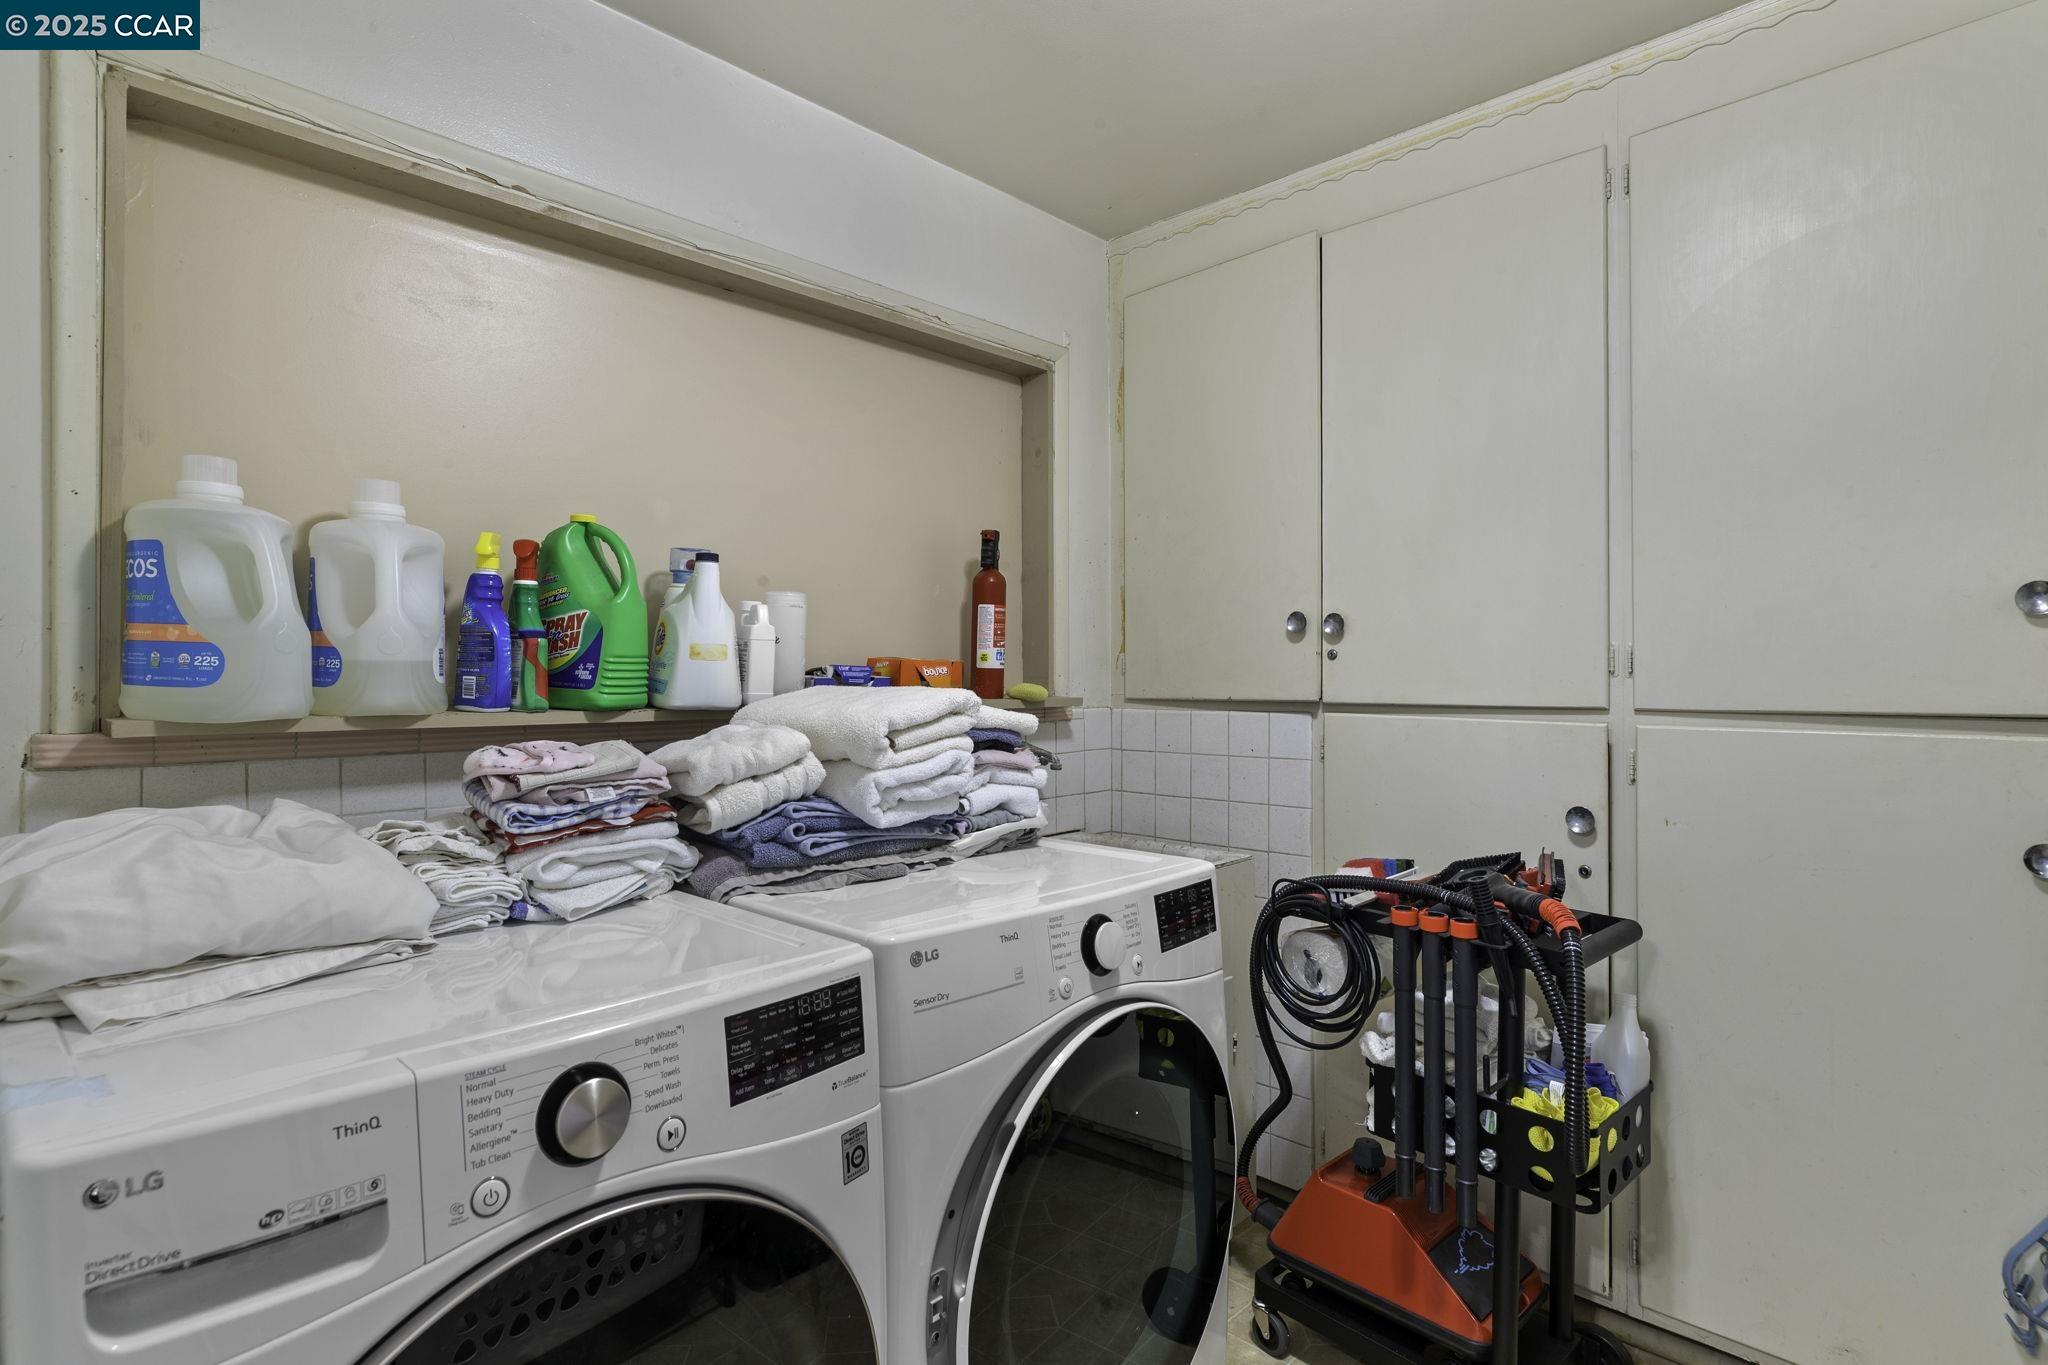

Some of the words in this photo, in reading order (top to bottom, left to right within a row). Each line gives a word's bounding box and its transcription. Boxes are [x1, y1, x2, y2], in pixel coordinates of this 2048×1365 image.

[549, 630, 580, 656] ASH
[194, 656, 219, 667] 225
[326, 659, 341, 669] 225
[1000, 932, 1019, 943] ThinQ
[924, 949, 939, 962] LG
[634, 1034, 655, 1046] Bright
[650, 1041, 679, 1055] Delicates
[643, 1060, 661, 1070] Perm.
[663, 1054, 680, 1064] Press
[464, 1071, 487, 1081] STEAM
[487, 1064, 507, 1074] CYCLE
[660, 1066, 680, 1079] Towels
[466, 1078, 496, 1093] Normal
[644, 1086, 663, 1098] Speed
[665, 1080, 682, 1091] Wash
[466, 1094, 493, 1107] Heavy
[494, 1088, 514, 1099] Duty
[645, 1093, 683, 1113] Downloaded
[467, 1107, 501, 1122] Bedding
[333, 1116, 382, 1140] ThinQ
[469, 1121, 503, 1138] Sanitary
[471, 1158, 486, 1170] Tub
[488, 1151, 512, 1164] Clean
[845, 1145, 865, 1174] 10
[125, 1169, 165, 1198] LG
[84, 1250, 134, 1271] Inverter
